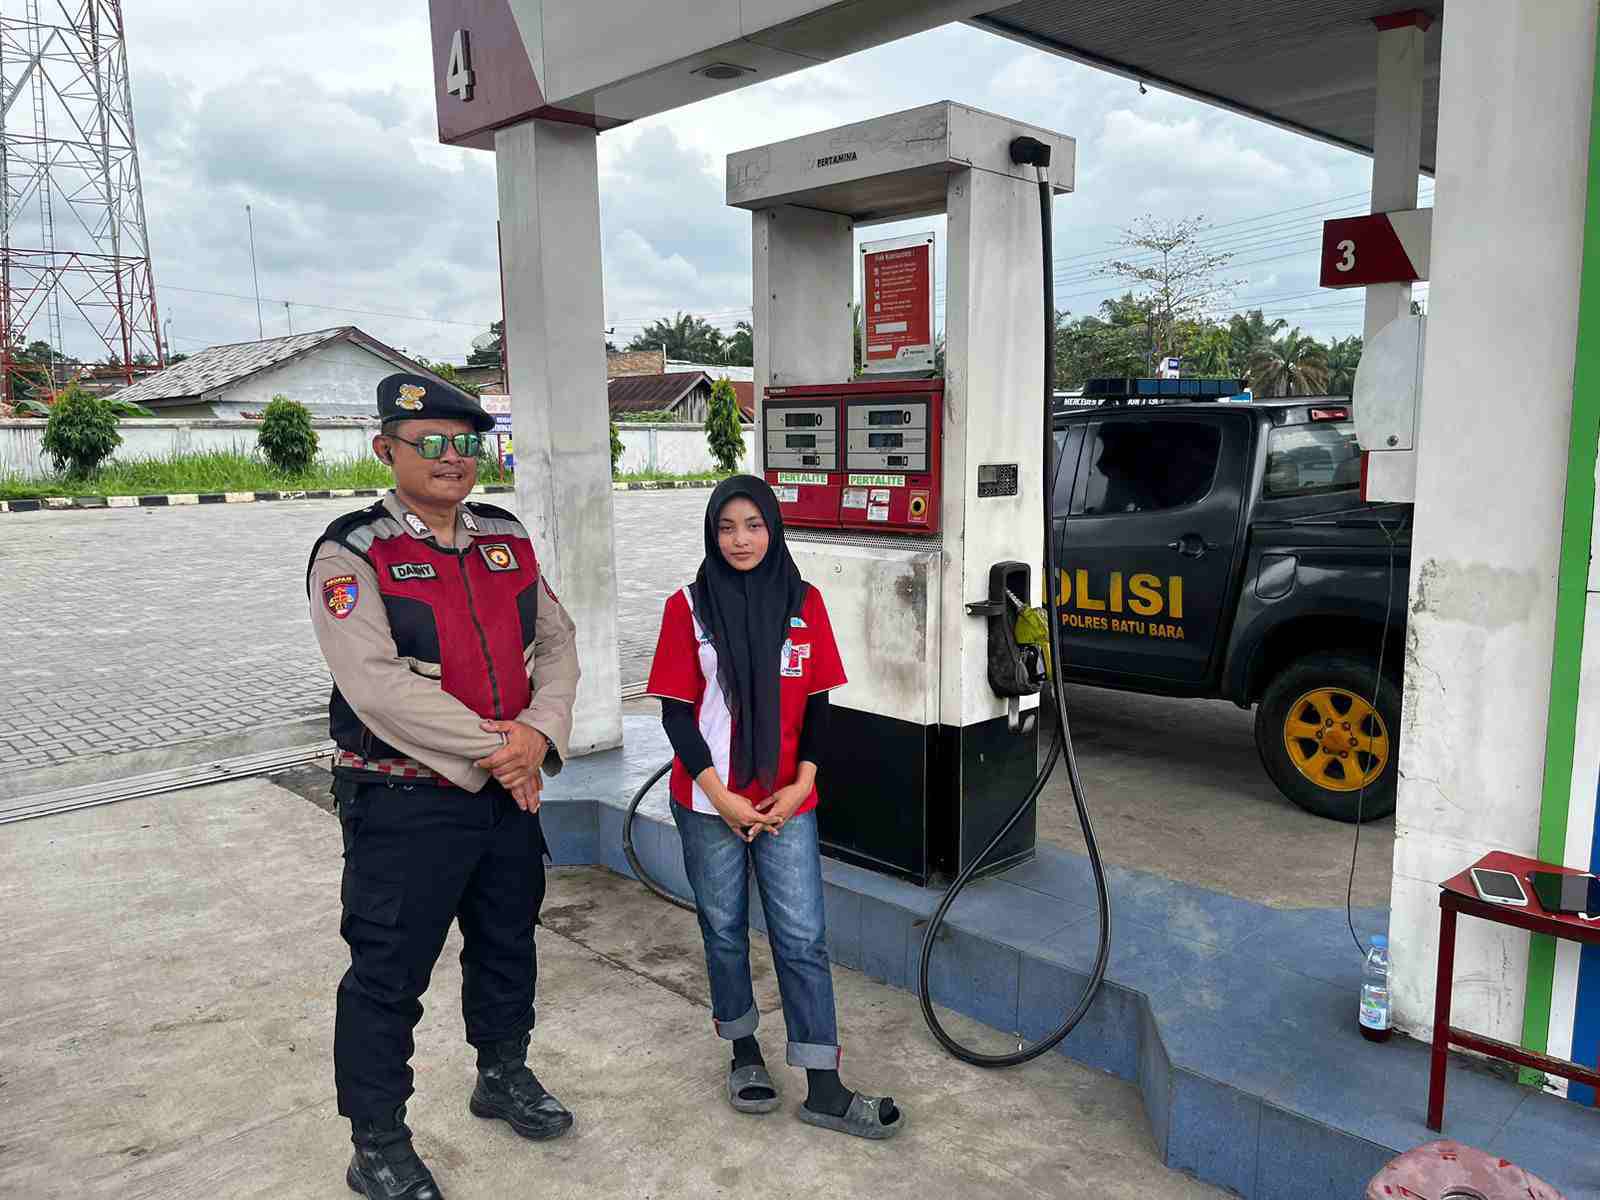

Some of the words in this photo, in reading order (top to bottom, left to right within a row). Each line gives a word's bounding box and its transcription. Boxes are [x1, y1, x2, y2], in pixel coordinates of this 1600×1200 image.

[447, 29, 472, 101] 4
[817, 151, 857, 168] PERTAMINA
[1335, 239, 1356, 272] 3
[779, 473, 827, 484] PERTALITE
[850, 475, 904, 486] PERTALITE
[1041, 567, 1184, 619] OLISI
[1062, 613, 1108, 630] POLRES
[1111, 618, 1145, 635] BATU
[1150, 623, 1185, 640] BARA
